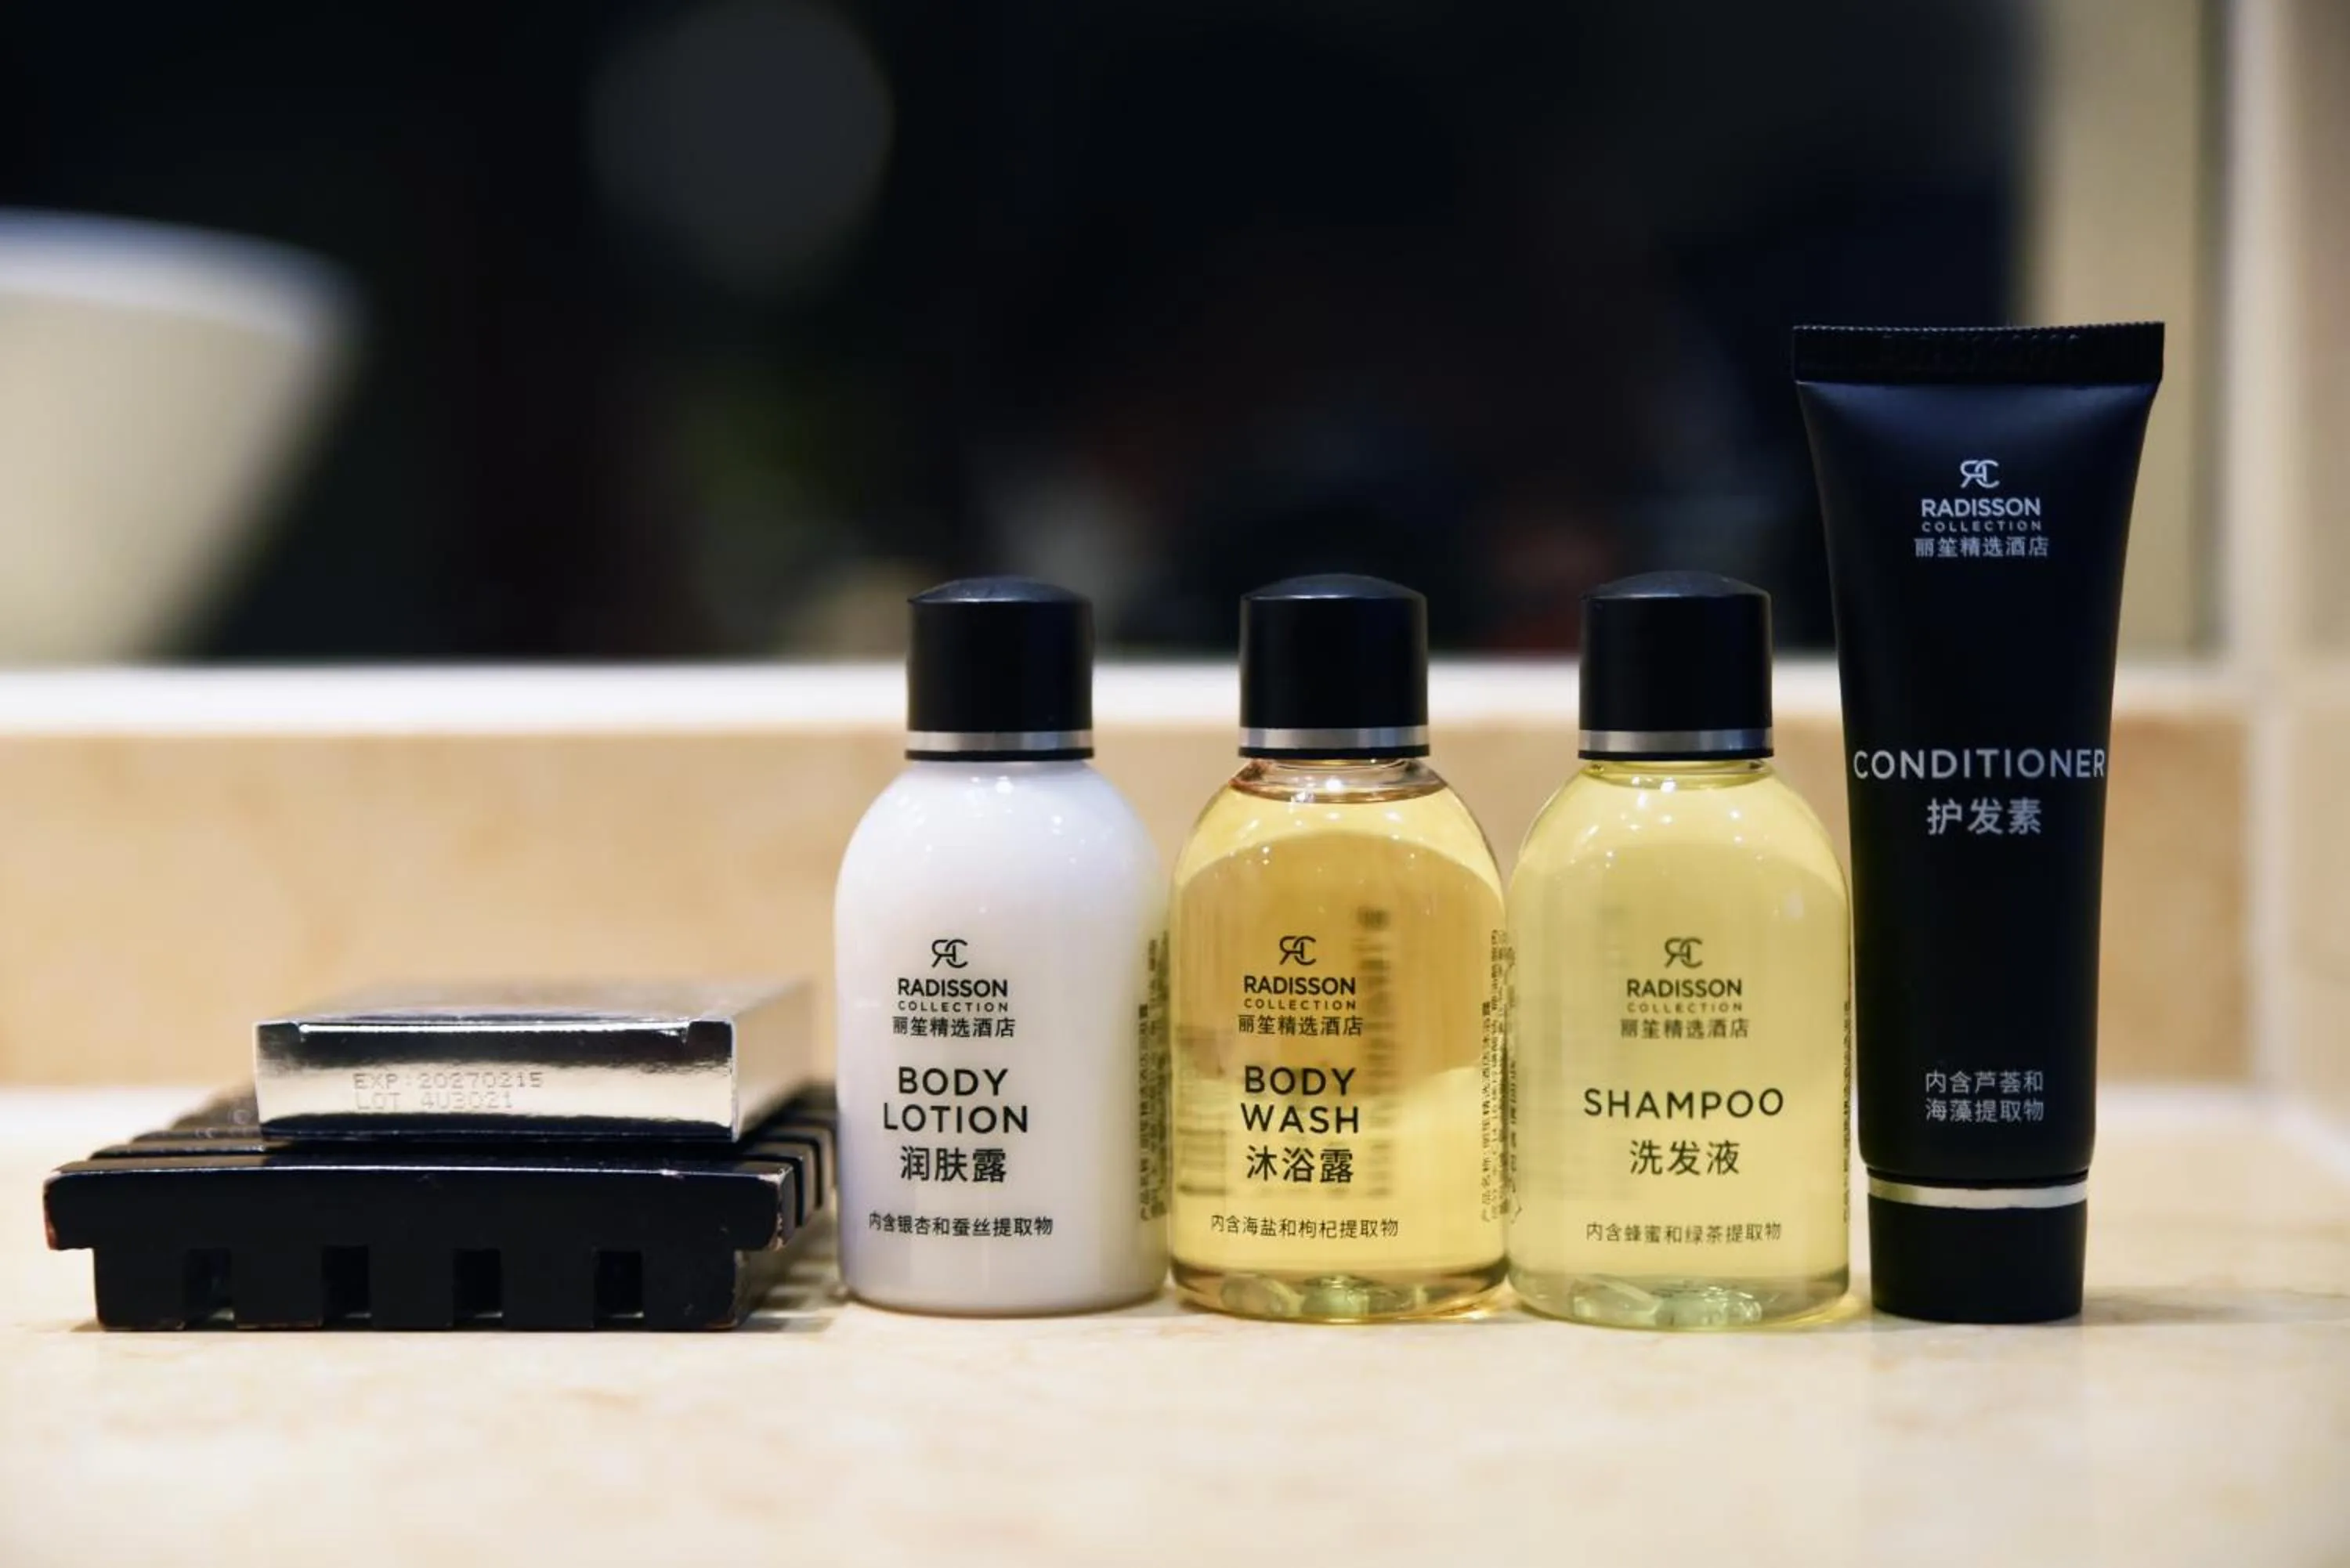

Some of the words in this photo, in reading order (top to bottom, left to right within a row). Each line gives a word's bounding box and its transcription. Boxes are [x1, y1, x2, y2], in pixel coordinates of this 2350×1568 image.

[1922, 498, 2041, 517] RADISSON
[1922, 520, 2041, 533] COLLECTION
[1914, 536, 2048, 557] 丽笙精选酒店
[1853, 749, 2105, 779] CONDITIONER
[1927, 798, 2041, 835] 护发素
[898, 977, 1007, 998] RADISSON
[1244, 975, 1355, 995] RADISSON
[1627, 979, 1741, 998] RADISSON
[898, 1000, 1007, 1013] COLLECTION
[1244, 998, 1356, 1010] COLLECTION
[1627, 1002, 1742, 1013] COLLECTION
[893, 1017, 1015, 1037] 丽笙精选酒店
[1238, 1015, 1363, 1036] 丽笙精选酒店
[1622, 1018, 1748, 1039] 丽笙精选酒店
[899, 1067, 1007, 1096] BODY
[1245, 1065, 1355, 1096] BODY
[1925, 1070, 2043, 1093] 内含芦荟和
[356, 1092, 401, 1110] LOT
[1585, 1088, 1783, 1118] SHAMPOO
[1925, 1098, 2044, 1122] 海藻提取物
[884, 1103, 1027, 1134] LOTION
[1241, 1103, 1358, 1134] WASH
[901, 1146, 1006, 1183] 润肤露
[1247, 1145, 1353, 1183] 沐浴露
[1630, 1140, 1739, 1175] 洗发液
[870, 1212, 1053, 1237] 内含银杏和蚕丝提取物
[1212, 1215, 1398, 1238] 内含海盐和枸杞提取物
[1587, 1222, 1781, 1245] 内含蜂蜜和绿茶提取物
